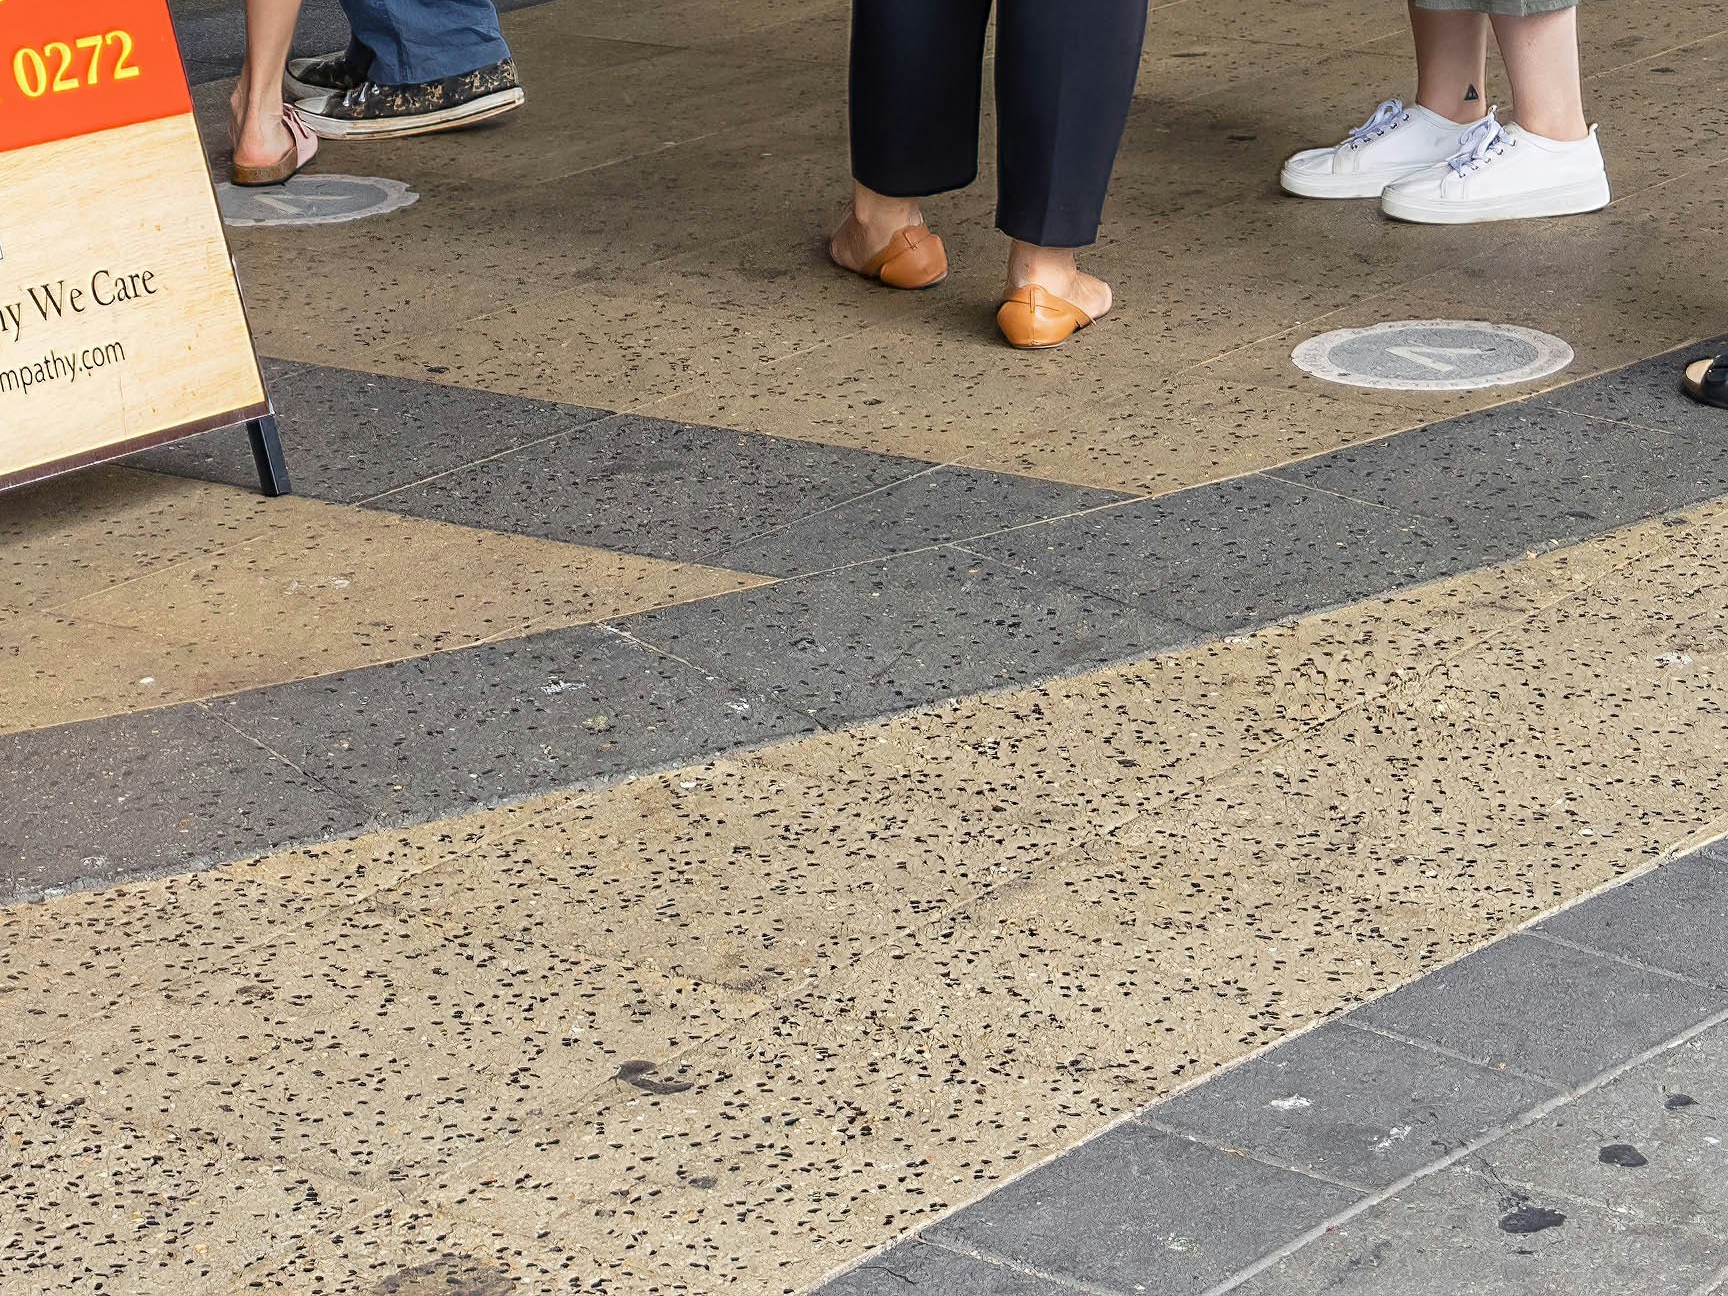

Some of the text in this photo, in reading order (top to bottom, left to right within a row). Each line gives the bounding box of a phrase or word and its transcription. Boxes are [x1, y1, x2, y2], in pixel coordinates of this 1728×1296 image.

[13, 30, 140, 98] 0272
[27, 279, 86, 321] We
[91, 269, 158, 307] Care
